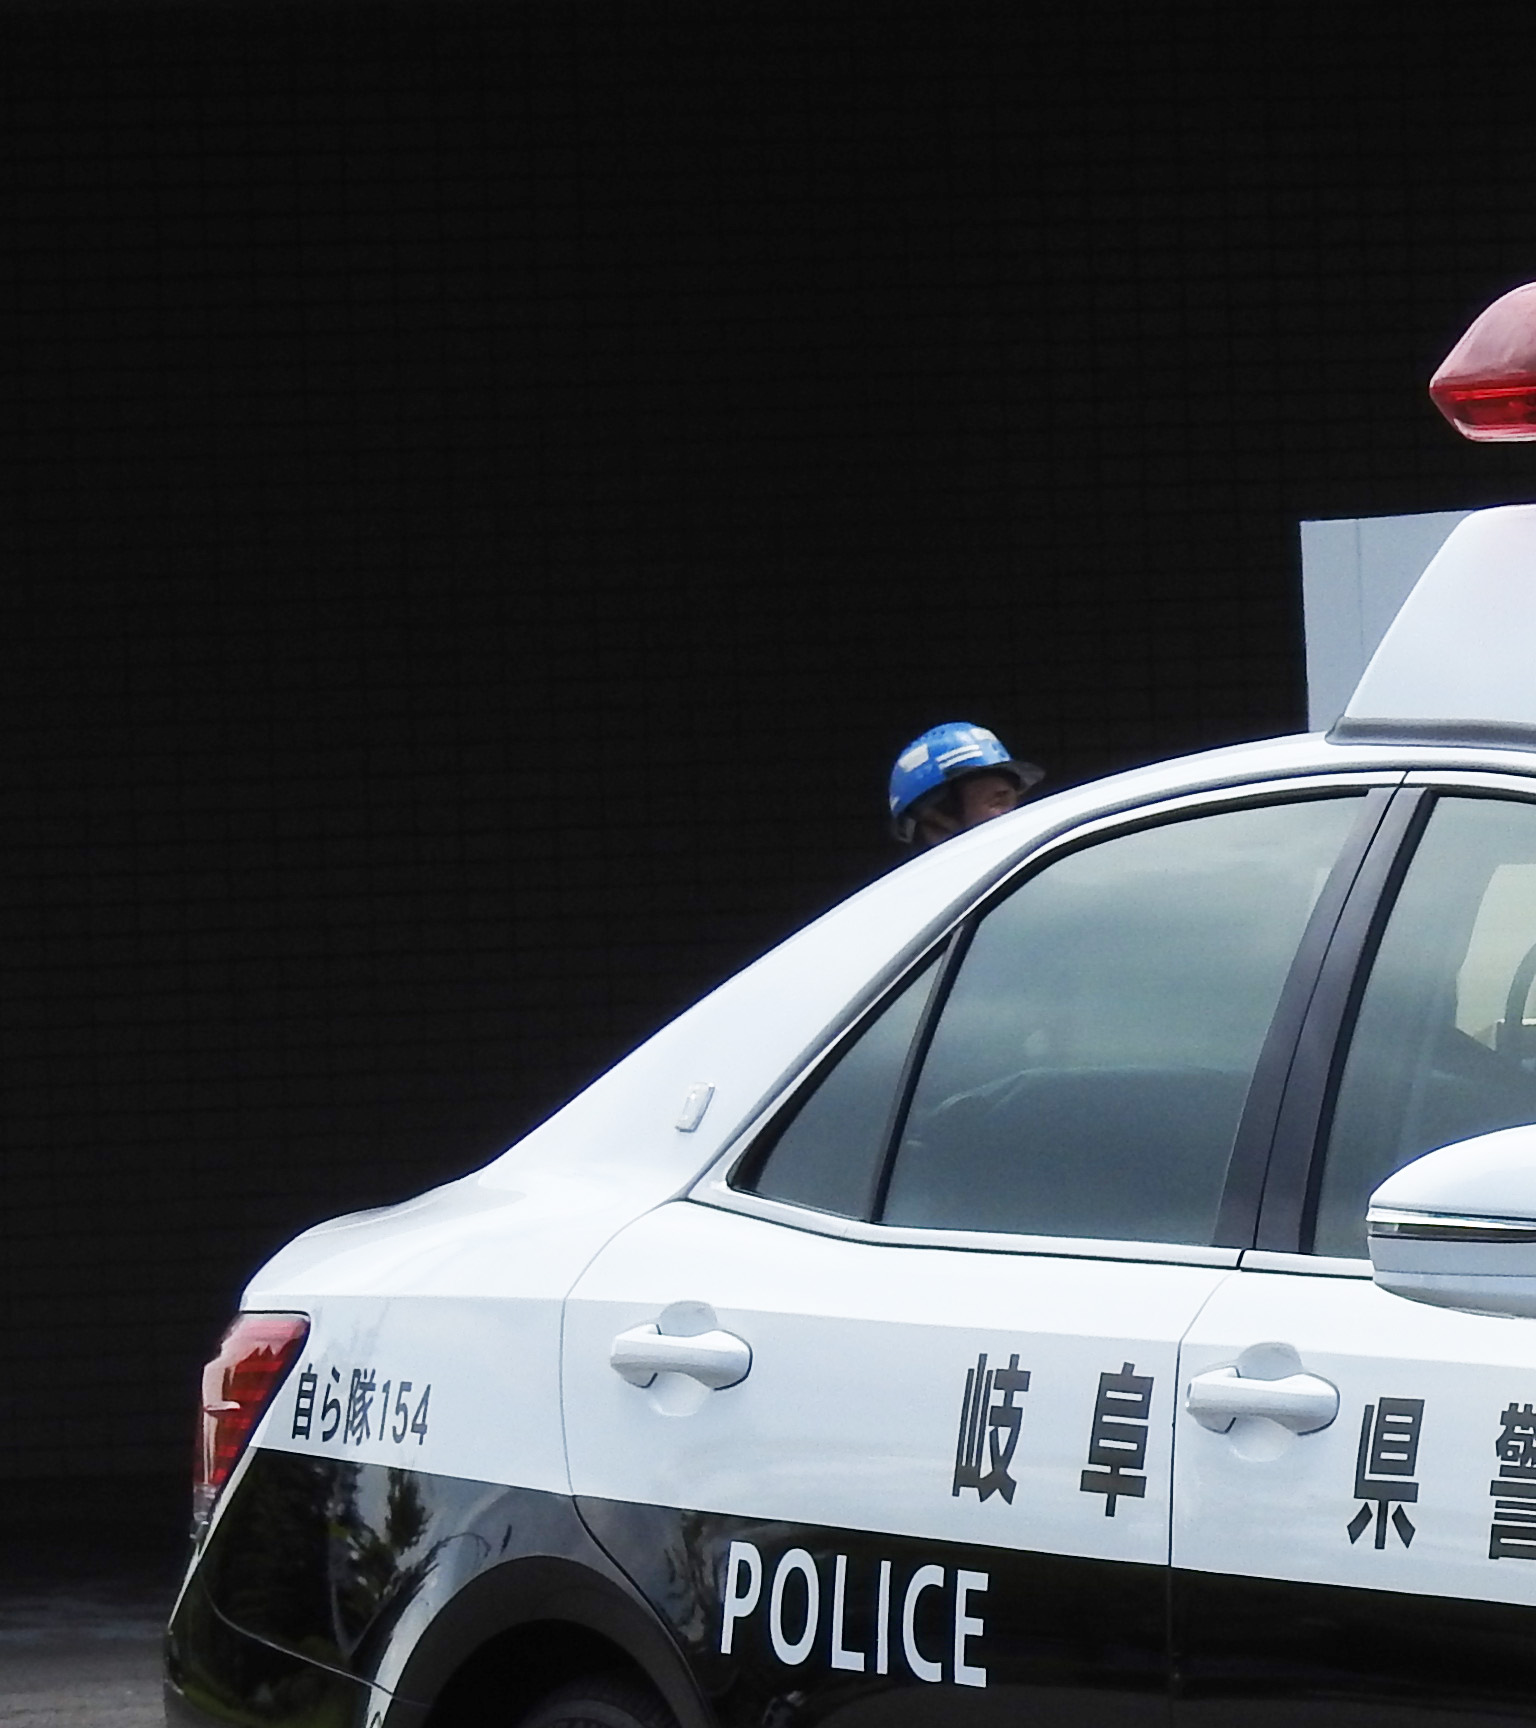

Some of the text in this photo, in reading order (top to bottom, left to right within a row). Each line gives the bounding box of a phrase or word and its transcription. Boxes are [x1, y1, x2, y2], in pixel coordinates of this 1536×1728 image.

[291, 1362, 431, 1446] 自ら隊154
[720, 1541, 989, 1688] POLICE
